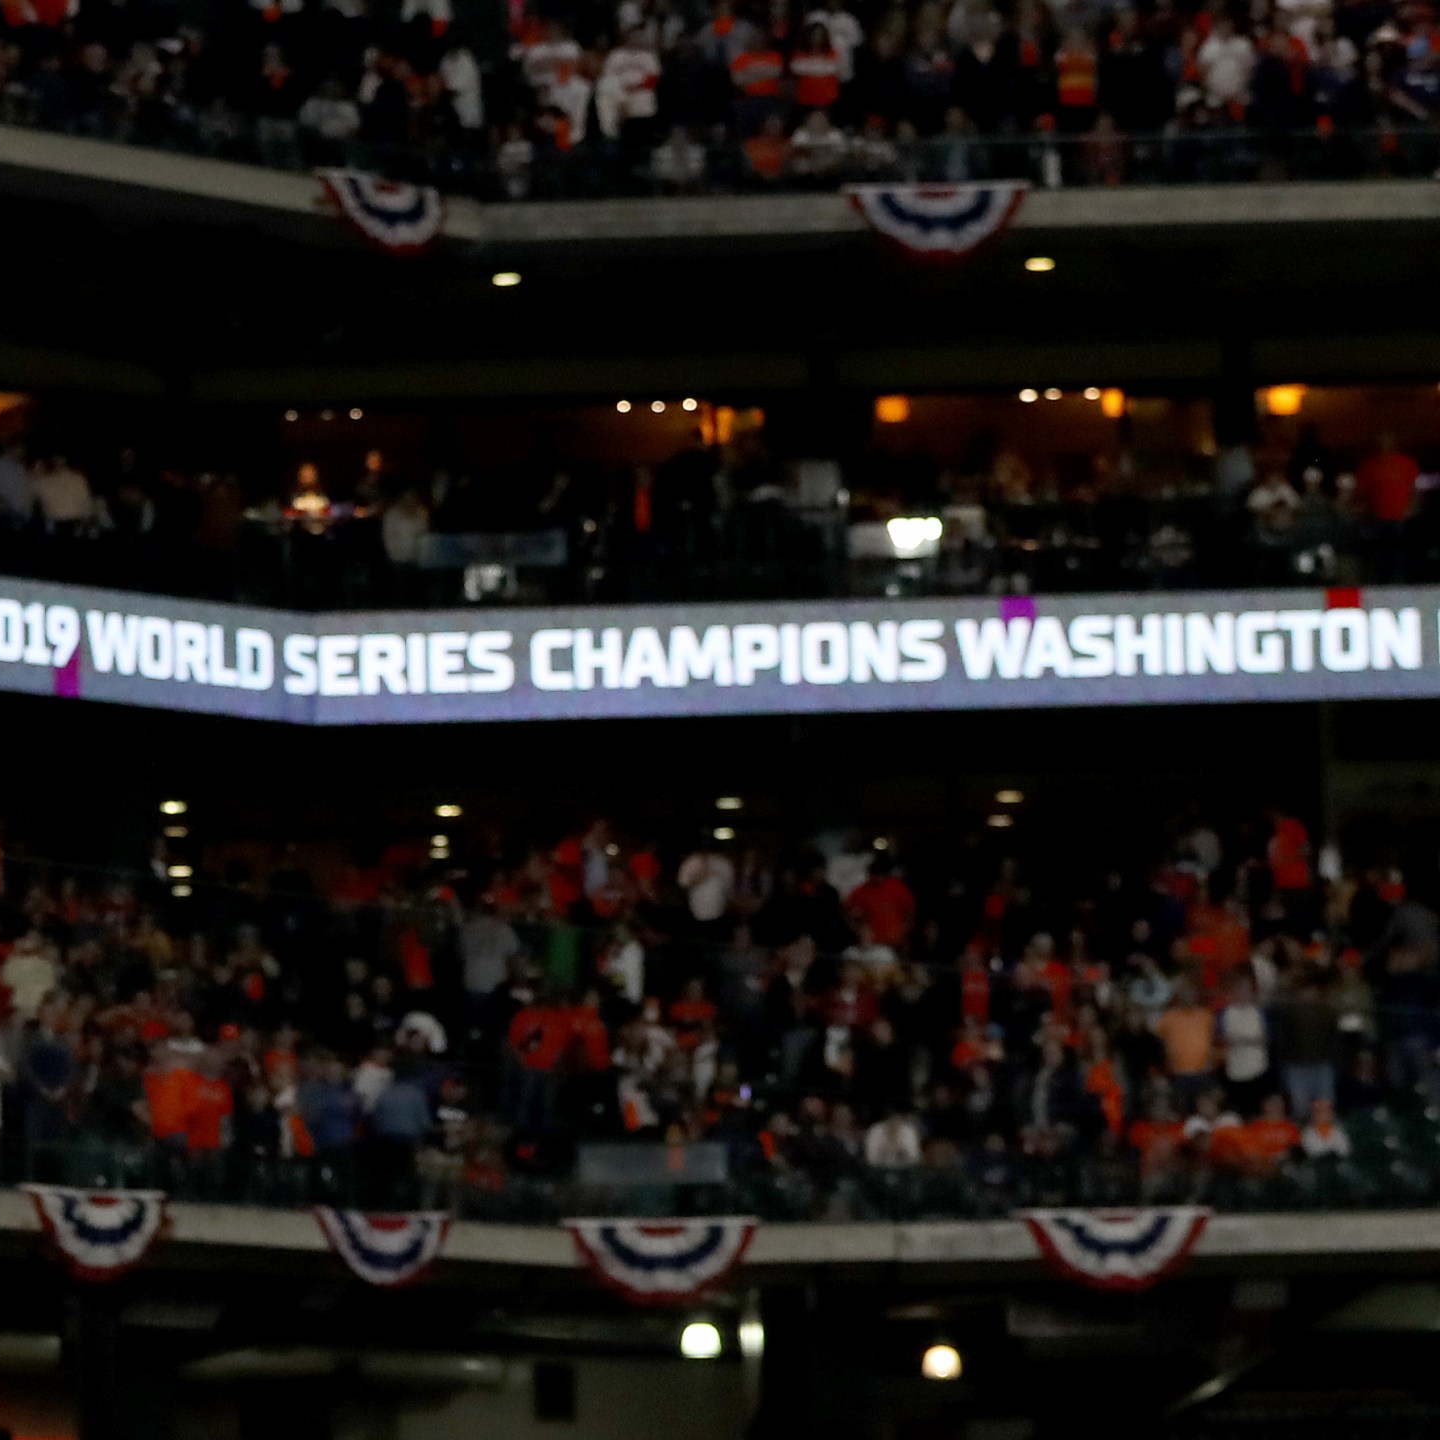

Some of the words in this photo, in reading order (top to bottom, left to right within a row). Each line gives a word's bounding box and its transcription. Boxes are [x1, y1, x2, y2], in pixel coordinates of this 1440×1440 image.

[85, 609, 276, 692] WORLD
[282, 630, 516, 697] SERIES
[528, 617, 948, 692] CHAMPIONS
[955, 606, 1422, 681] WASHINGTON
